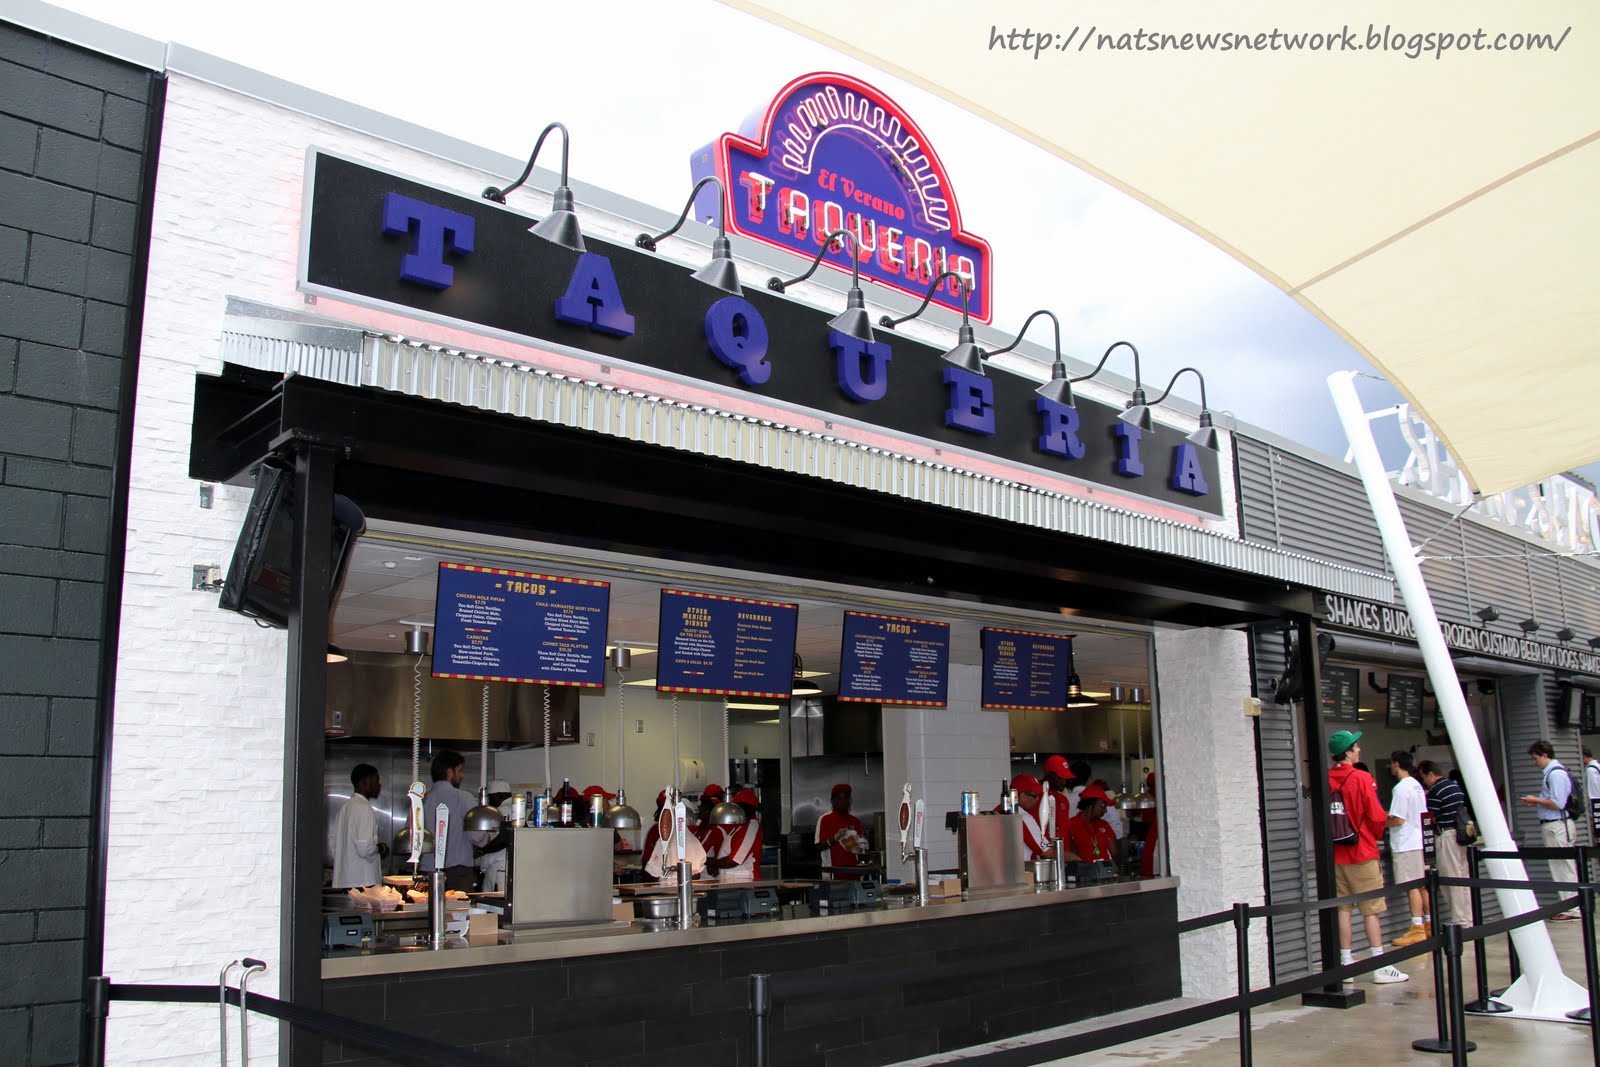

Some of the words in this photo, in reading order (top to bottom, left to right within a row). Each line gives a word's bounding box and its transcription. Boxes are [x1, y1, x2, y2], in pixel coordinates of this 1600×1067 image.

[818, 168, 838, 192] El
[840, 176, 906, 220] Verano
[740, 170, 975, 301] TAQUERIA
[381, 191, 1208, 497] TAQUERIA
[507, 581, 546, 596] TACOS
[682, 613, 711, 621] MEXICAN
[738, 613, 771, 622] BEVERAGES
[886, 623, 910, 634] TACOS
[1325, 594, 1380, 631] SHAKES
[1382, 608, 1417, 638] BURG
[1480, 630, 1520, 658] CUSTARD
[1520, 639, 1541, 662] BEER
[1540, 644, 1558, 666] HOT
[1558, 646, 1579, 670] DOGS
